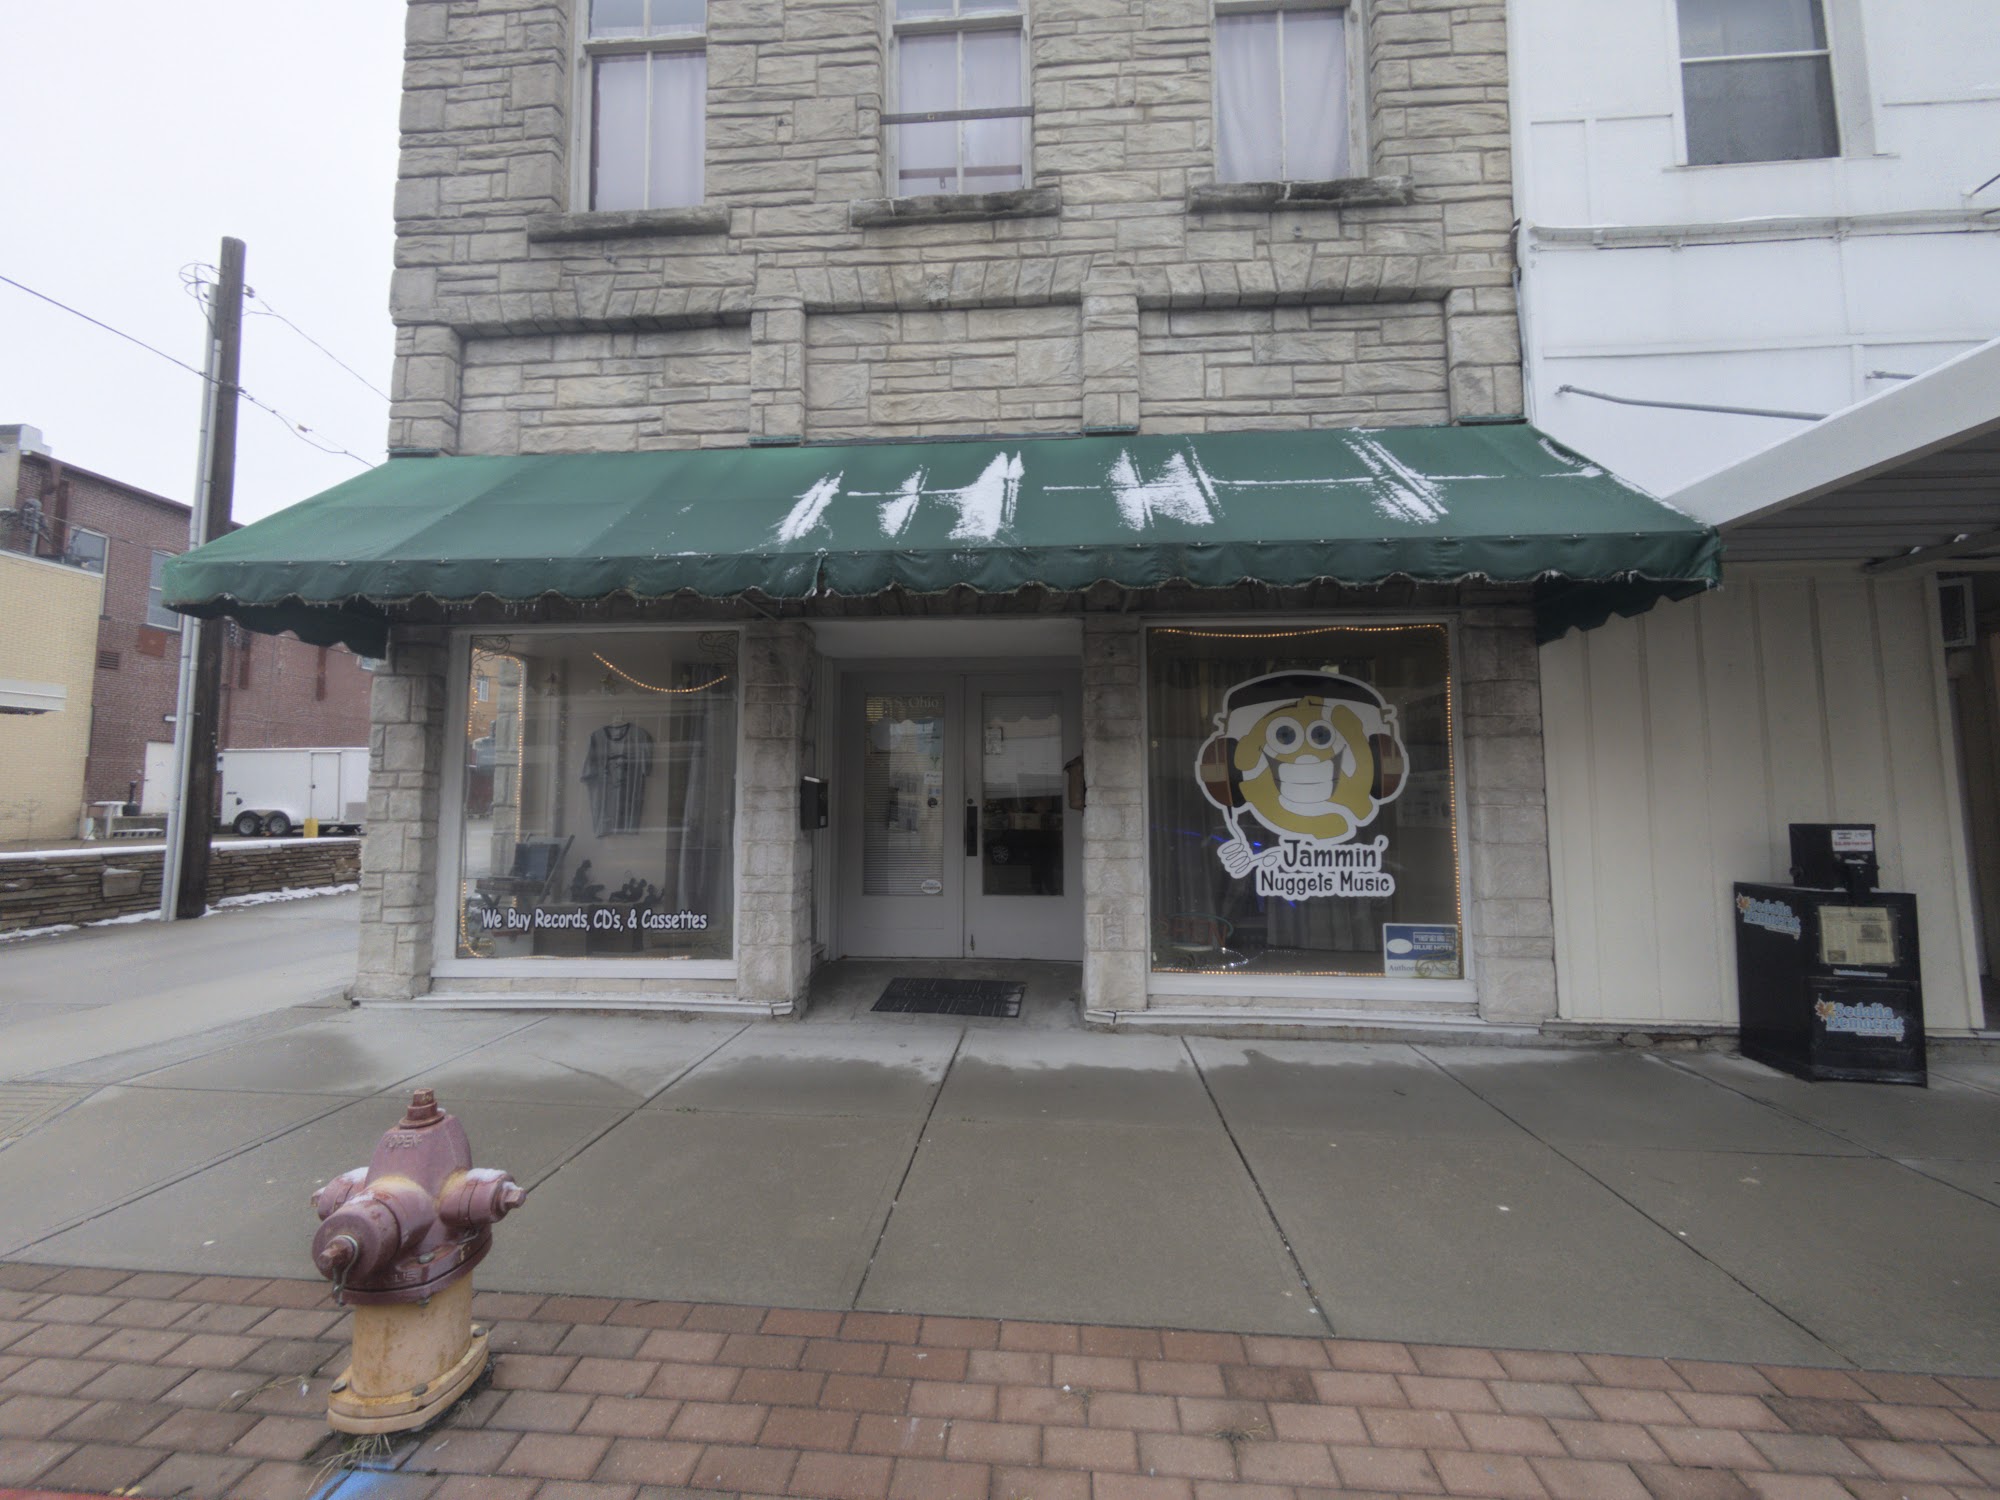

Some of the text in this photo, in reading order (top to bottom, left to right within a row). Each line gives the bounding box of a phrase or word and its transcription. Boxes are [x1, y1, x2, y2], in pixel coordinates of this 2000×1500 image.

[908, 694, 939, 709] Ohio
[1283, 839, 1384, 868] Jammin'
[1260, 868, 1390, 896] Nuggets Music
[1749, 899, 1792, 917] Sedalia
[481, 908, 708, 932] We Buy Records, CD's, & Cassettes
[1835, 1002, 1893, 1019] Sedalia
[1826, 1016, 1903, 1031] Democrat
